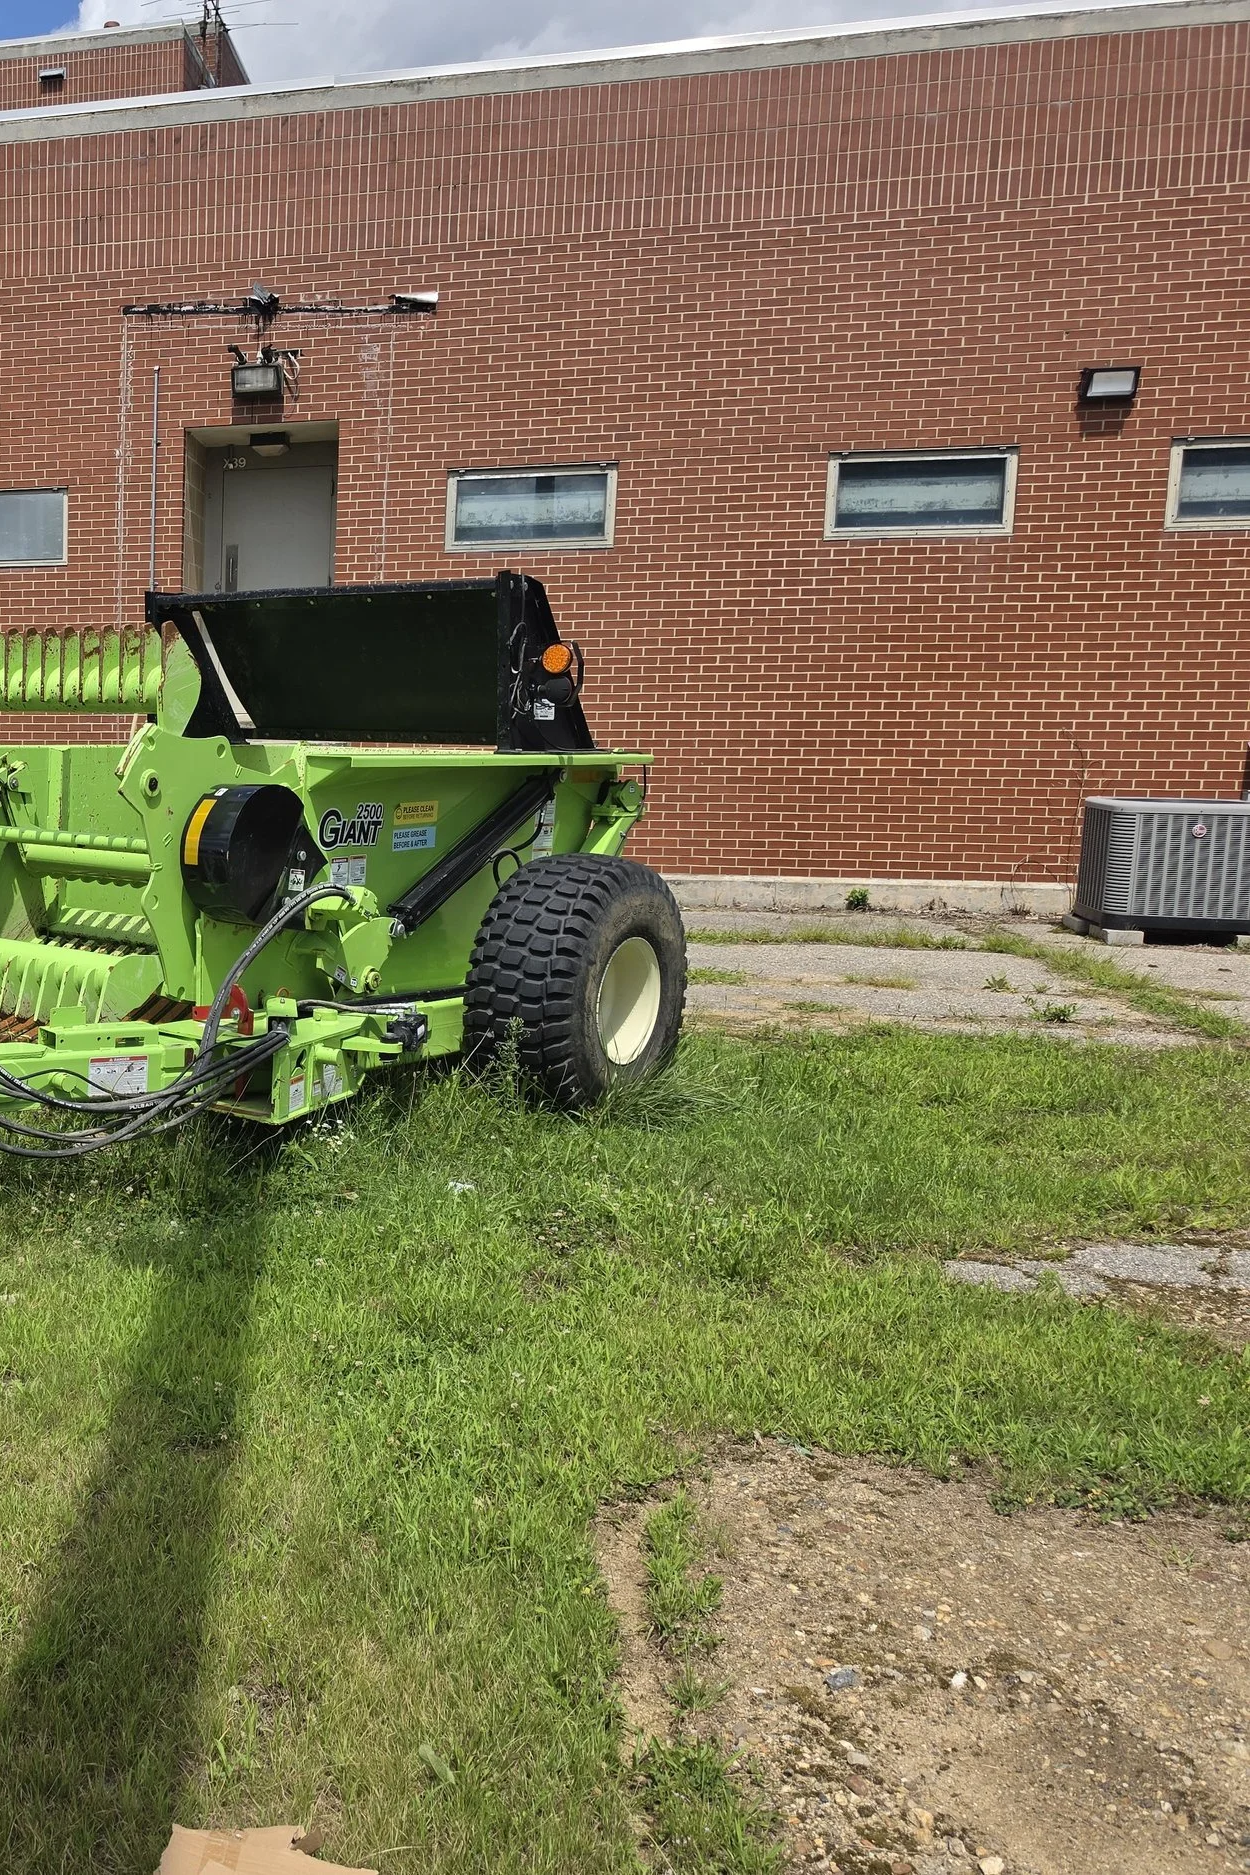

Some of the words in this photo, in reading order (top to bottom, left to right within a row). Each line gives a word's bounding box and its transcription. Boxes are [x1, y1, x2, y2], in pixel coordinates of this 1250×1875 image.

[356, 804, 383, 820] 2500
[318, 808, 383, 849] GIANT
[394, 831, 410, 839] PLEASE
[411, 829, 427, 838] GREASE
[394, 841, 410, 850] BEFORE
[414, 839, 427, 847] AFTER
